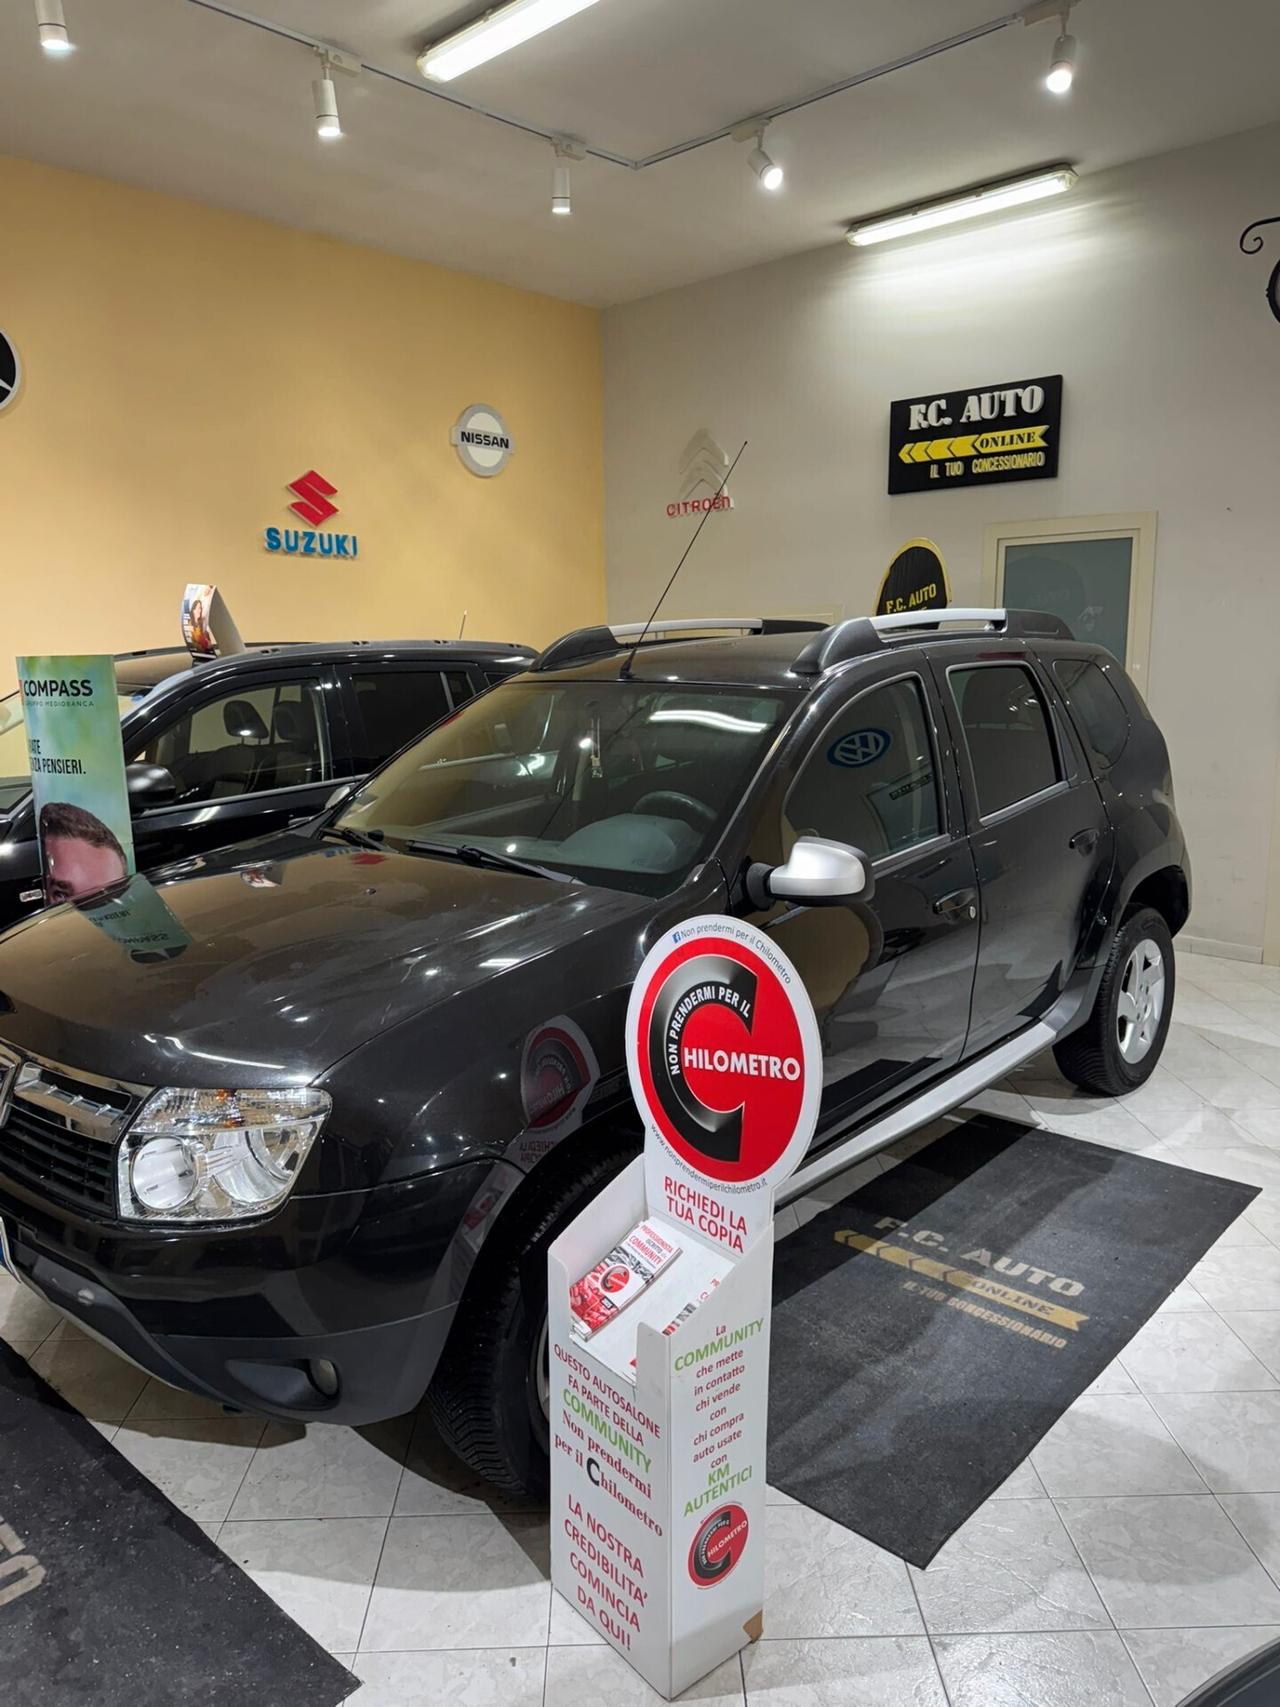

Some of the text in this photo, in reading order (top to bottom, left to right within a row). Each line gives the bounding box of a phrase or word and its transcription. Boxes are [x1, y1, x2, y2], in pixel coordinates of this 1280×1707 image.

[908, 385, 1044, 430] F.C. AUTO
[461, 431, 509, 449] NISSAN
[979, 431, 1036, 449] ONLINE
[930, 451, 1045, 479] IL TUO CONCESSIONARIO
[266, 527, 358, 558] SUZUKI
[908, 583, 937, 607] AUTO
[24, 679, 93, 697] COMPASS
[42, 758, 86, 774] PENSIERI.
[680, 929, 695, 938] Non
[696, 922, 735, 936] prendermi
[735, 928, 749, 941] per
[755, 939, 791, 984] Chilometro
[668, 985, 751, 1075] NON PRENDERMI PER IL
[664, 1176, 747, 1235] RICHIEDI LA
[666, 1195, 744, 1253] TUA COPIA
[630, 1235, 663, 1265] COMMUNITY
[959, 1248, 1085, 1297] AUTO
[970, 1279, 1056, 1316] ONLINE
[715, 1324, 727, 1336] La
[947, 1297, 1067, 1349] CONCESSIONARIO
[674, 1317, 764, 1371] COMMUNITY
[694, 1364, 745, 1396] in contatto
[696, 1349, 744, 1378] che mette
[554, 1344, 661, 1439] QUESTO AUTOSALONE
[568, 1374, 644, 1446] FA PARTE DELLA
[695, 1382, 741, 1412] chi vende
[563, 1388, 652, 1473] COMMUNITY
[693, 1412, 744, 1446] chi compra
[709, 1406, 727, 1421] con
[563, 1410, 652, 1500] Non prendermi
[692, 1429, 742, 1463] auto usate
[710, 1454, 727, 1469] con
[554, 1434, 663, 1537] per il Chilometro
[683, 1465, 752, 1517] AUTENTICI
[707, 1462, 730, 1486] KM
[568, 1494, 644, 1578] LA NOSTRA
[570, 1552, 640, 1632] COMINCIA
[577, 1585, 631, 1651] DA QUI!
